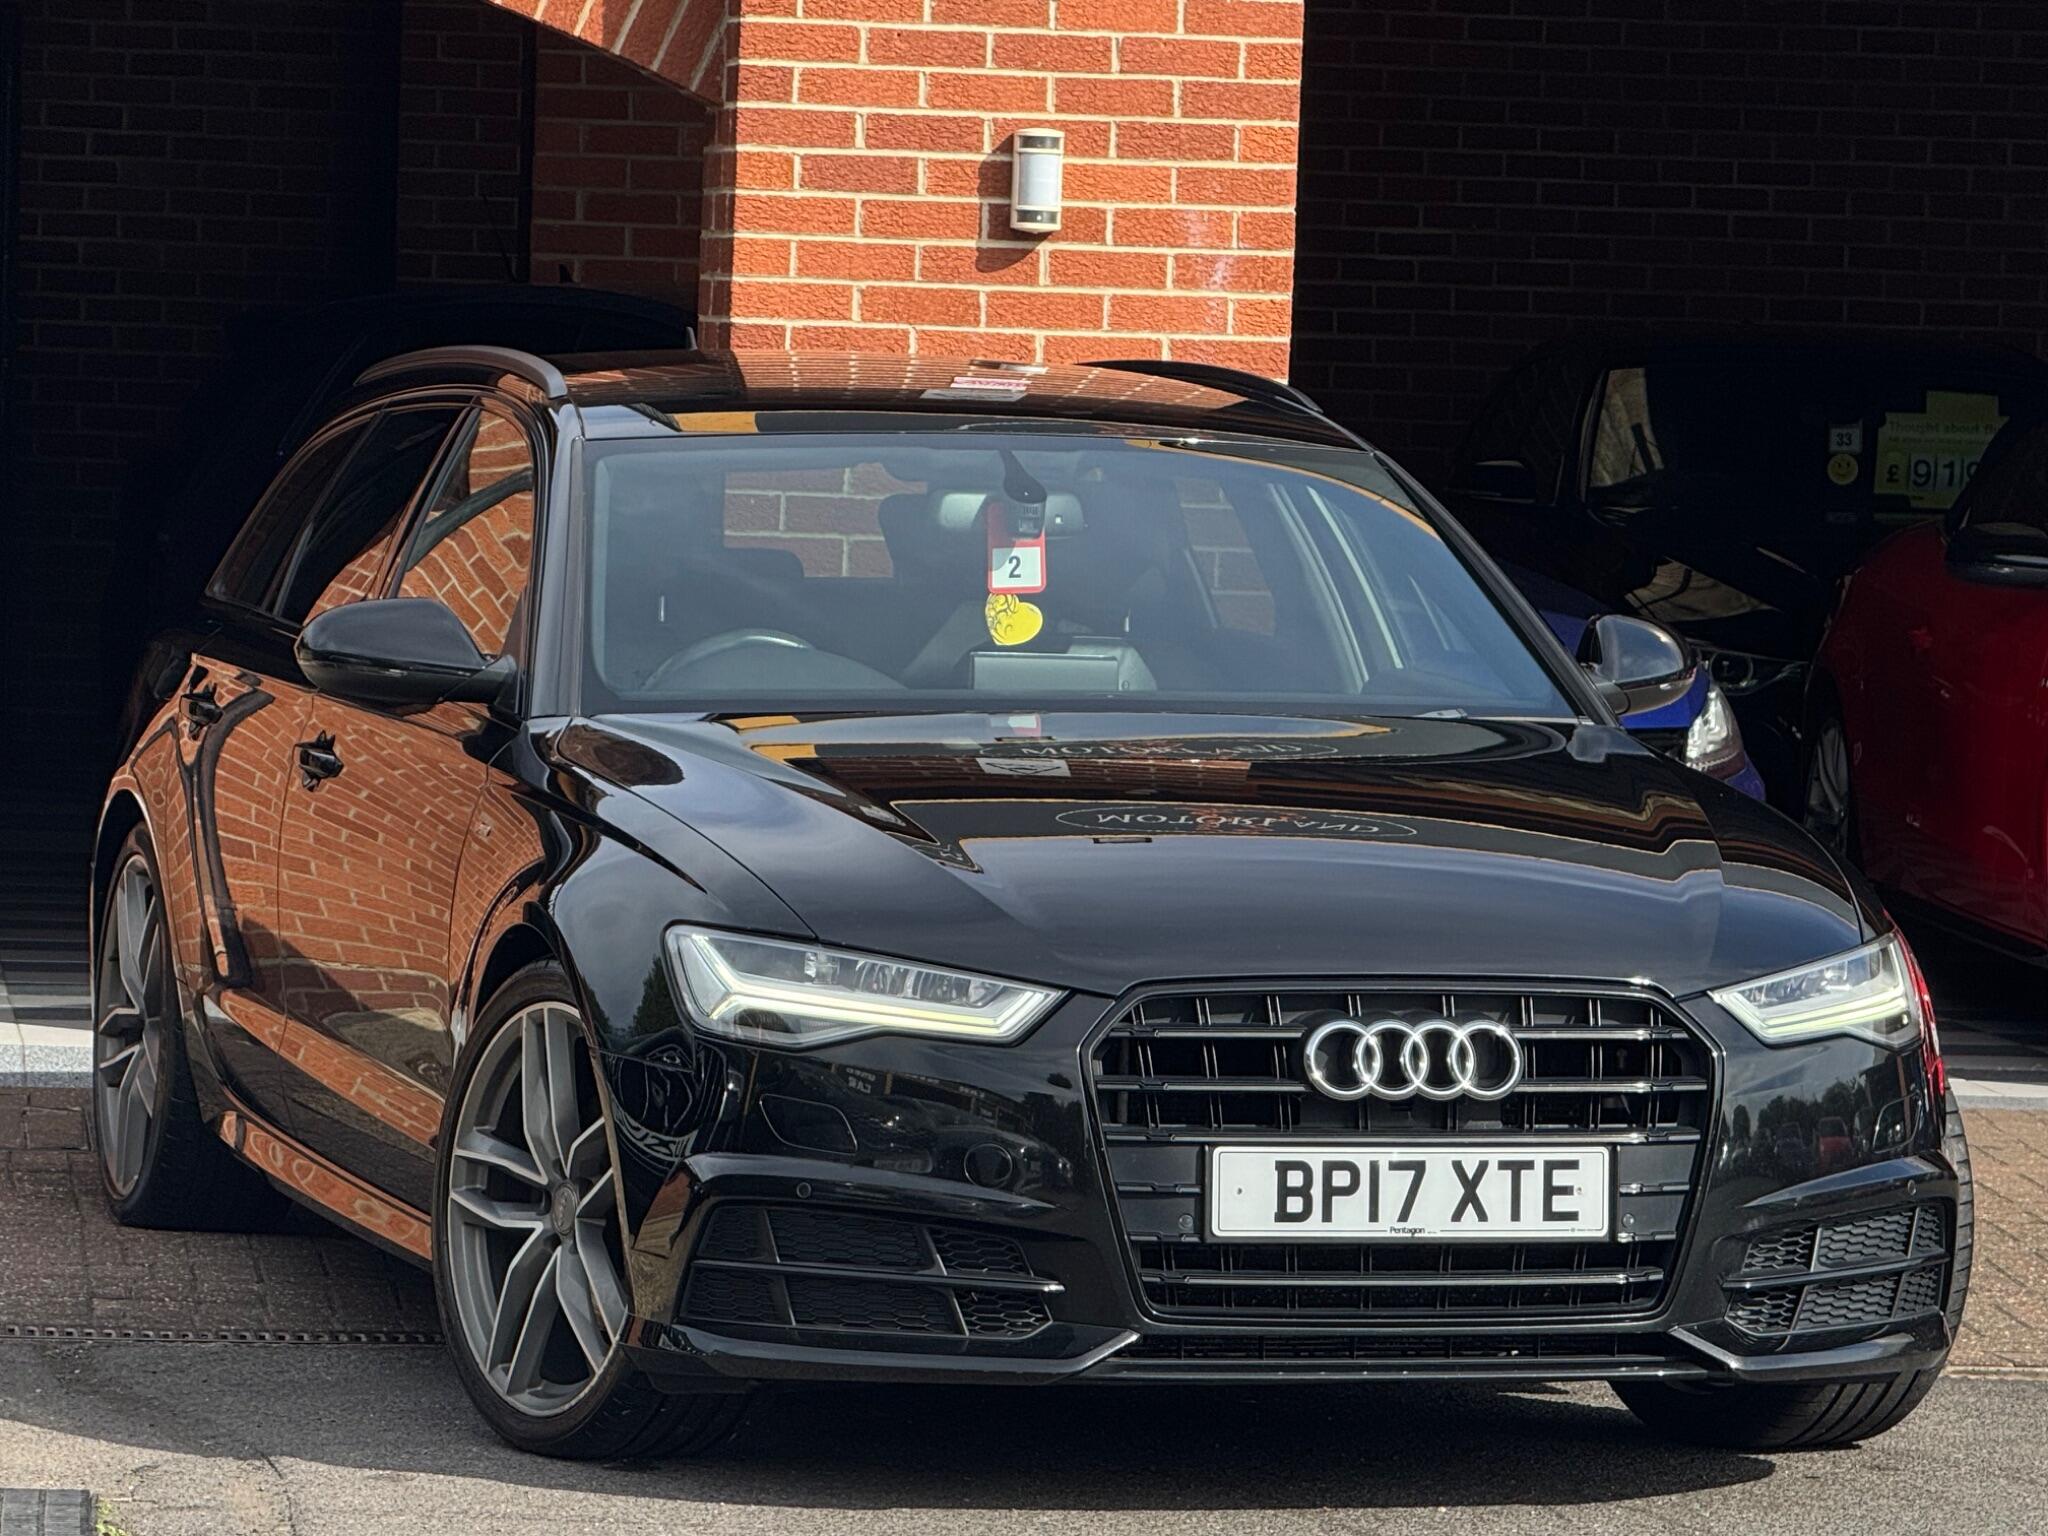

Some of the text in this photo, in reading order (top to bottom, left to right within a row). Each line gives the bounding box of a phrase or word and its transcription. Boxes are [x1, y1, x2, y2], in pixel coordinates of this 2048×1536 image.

[1944, 422, 1982, 434] about
[1836, 432, 1853, 447] 33
[1008, 556, 1022, 579] 2
[1274, 1159, 1580, 1224] BP17 XTE
[1389, 1226, 1426, 1238] Pentagon
